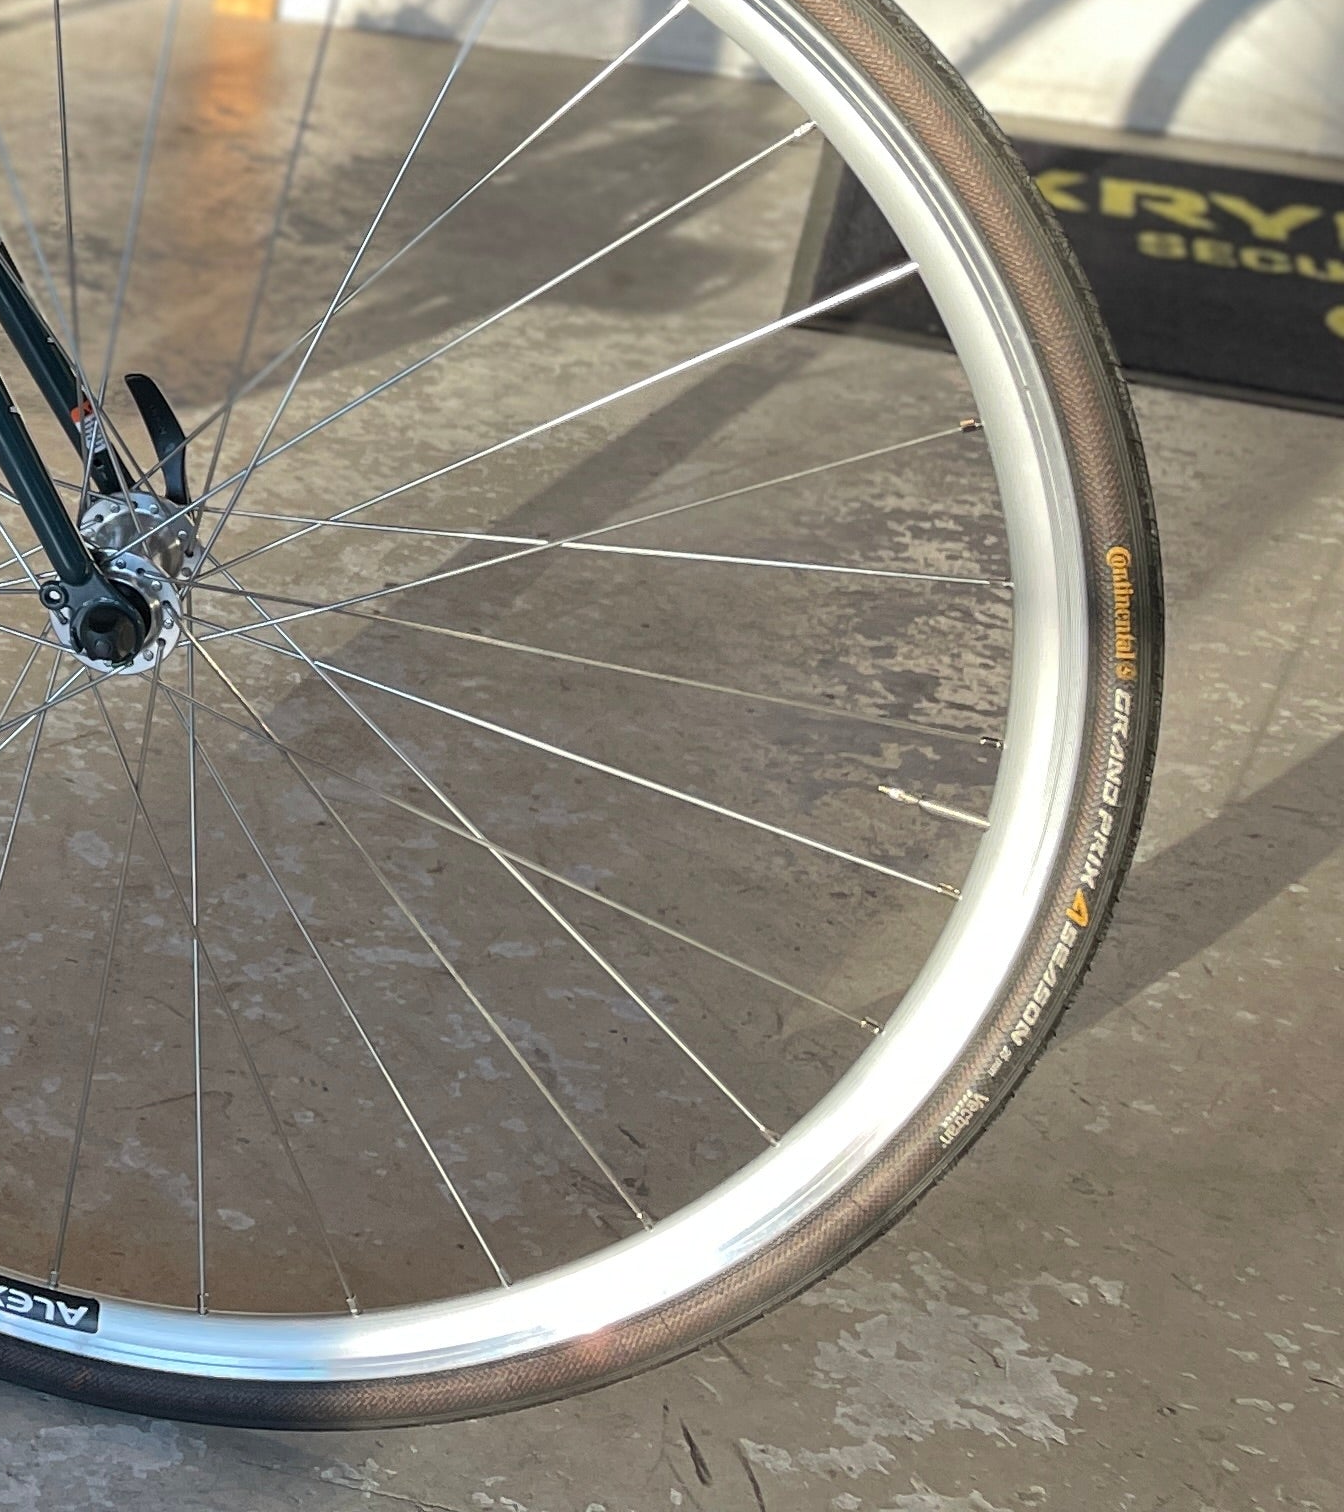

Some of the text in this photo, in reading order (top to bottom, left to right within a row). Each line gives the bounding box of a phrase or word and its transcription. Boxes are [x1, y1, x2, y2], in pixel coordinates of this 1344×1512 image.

[1033, 169, 1344, 250] KRY
[1011, 545, 1136, 1047] Continental GRAND PRIX 4 SEASON
[939, 1092, 990, 1143] Vectran
